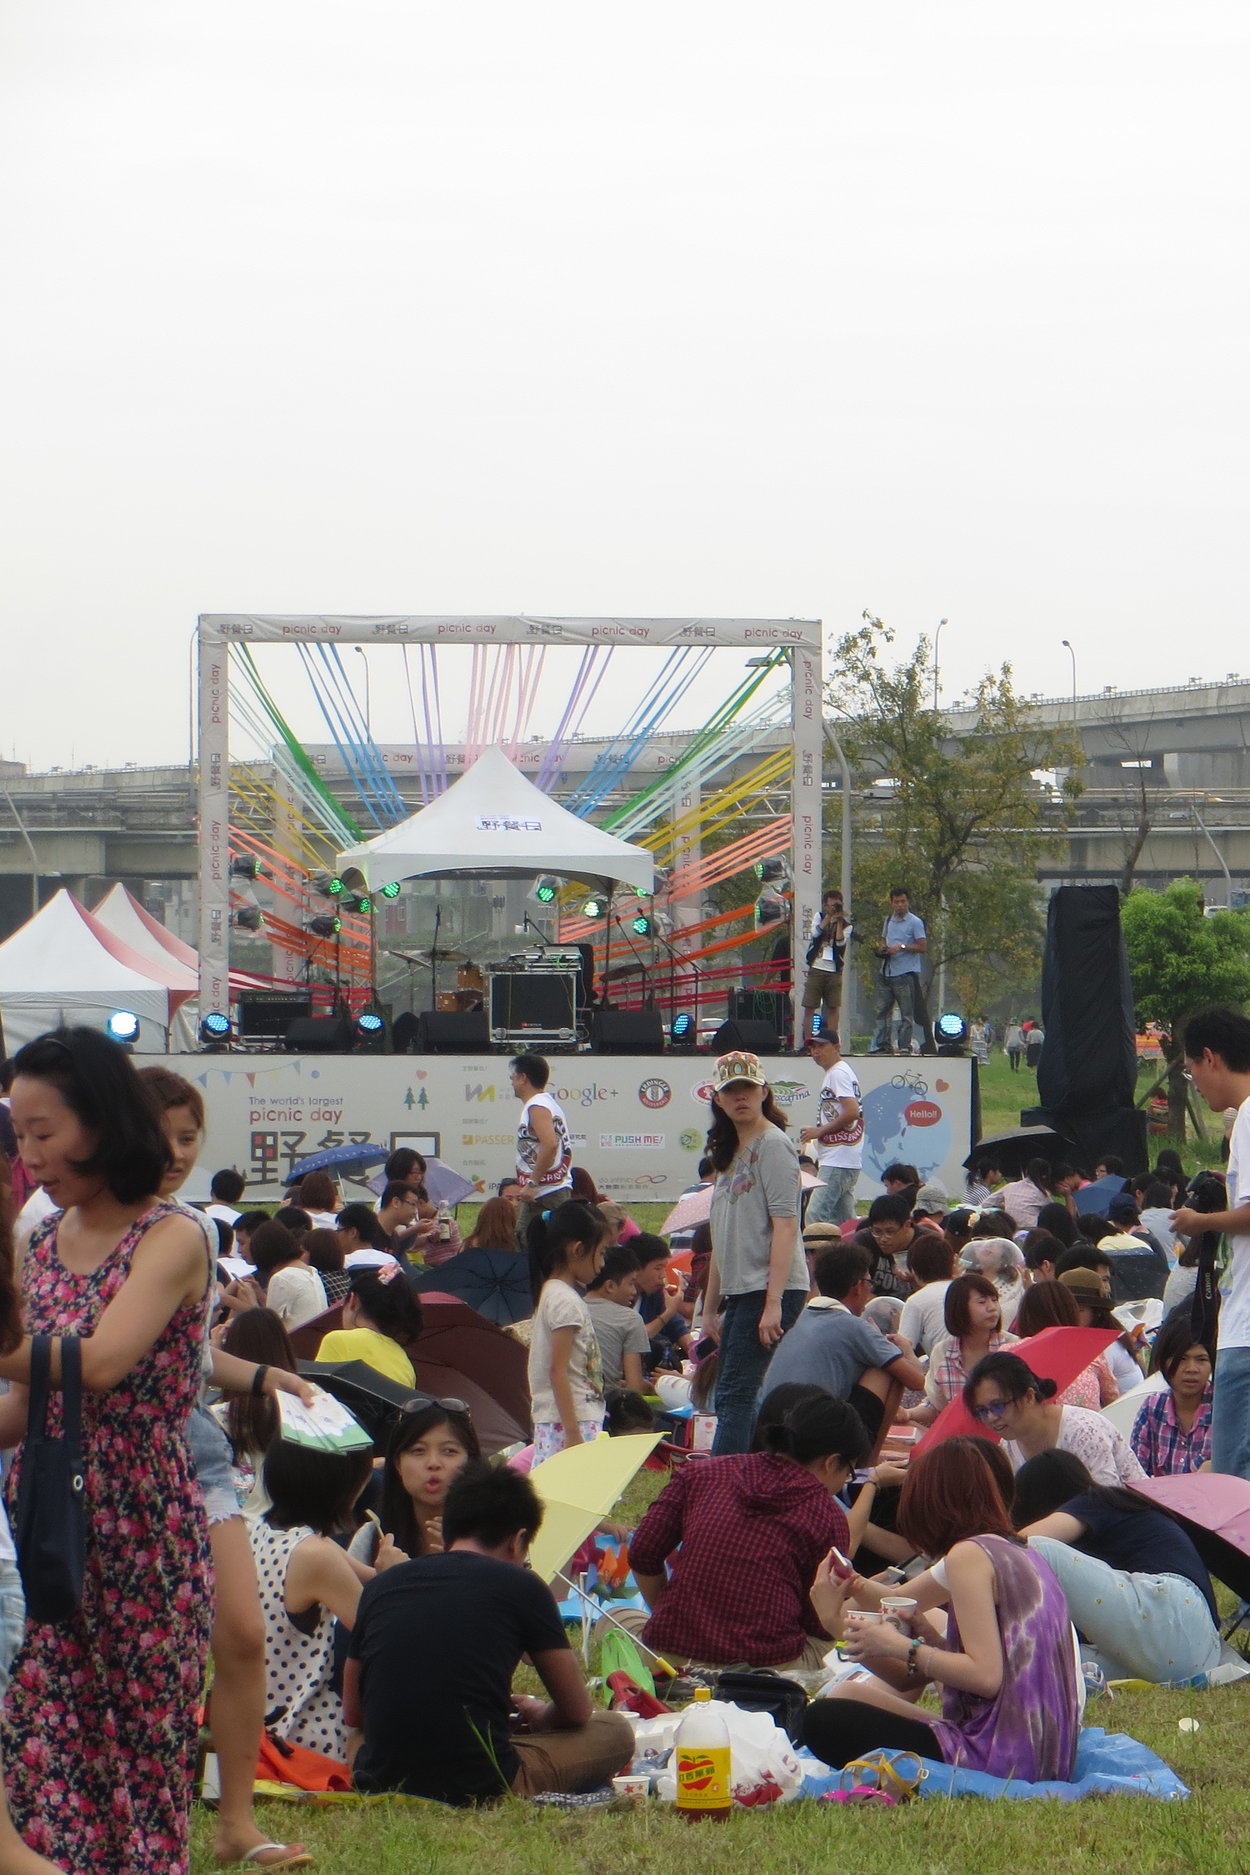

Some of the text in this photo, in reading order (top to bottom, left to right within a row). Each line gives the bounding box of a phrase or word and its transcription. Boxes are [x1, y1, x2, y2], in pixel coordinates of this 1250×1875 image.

[283, 624, 342, 635] picnic day
[438, 623, 497, 634] picnic day
[592, 626, 650, 637] picnic day
[745, 627, 803, 639] picnic day
[211, 664, 221, 723] picnic day
[802, 661, 812, 720] picnic day
[211, 821, 222, 880] picnic day
[802, 815, 812, 875] picnic day
[249, 1096, 343, 1107] The world's largest
[250, 1107, 343, 1126] picnic day
[909, 1109, 938, 1119] Hello!!
[615, 1135, 641, 1144] PUSH
[643, 1135, 663, 1145] ME!
[1205, 1272, 1213, 1300] Canon
